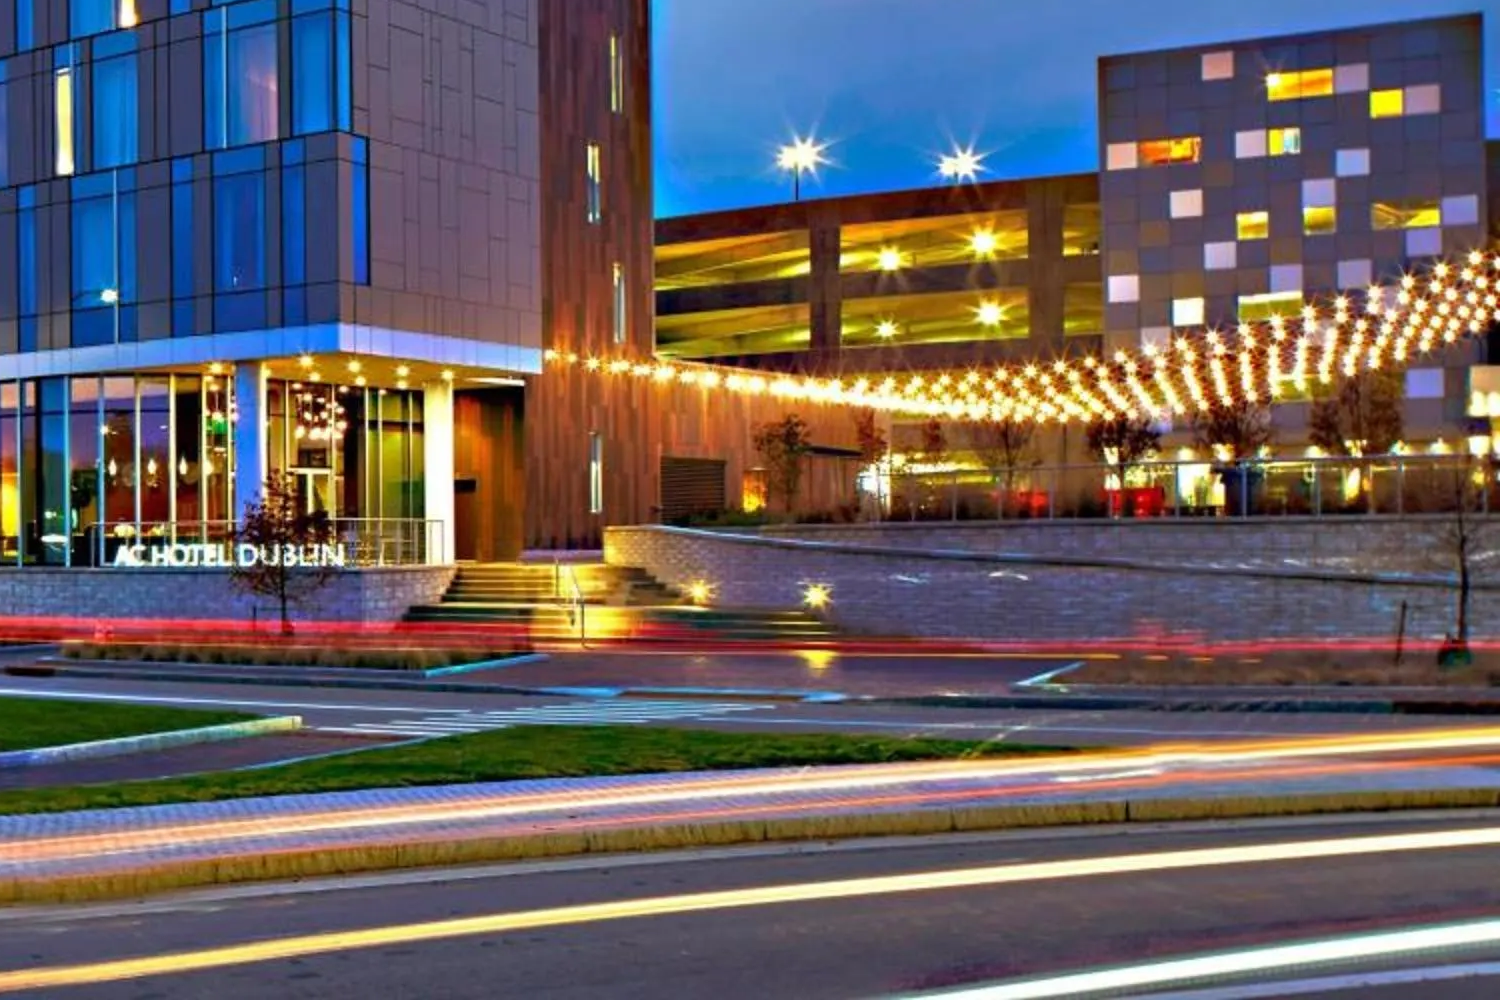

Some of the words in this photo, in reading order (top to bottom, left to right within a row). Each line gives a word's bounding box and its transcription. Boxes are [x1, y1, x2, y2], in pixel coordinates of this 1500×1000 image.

[113, 544, 148, 567] AC
[150, 543, 234, 567] HOTEL
[238, 543, 345, 567] DUBLIN
